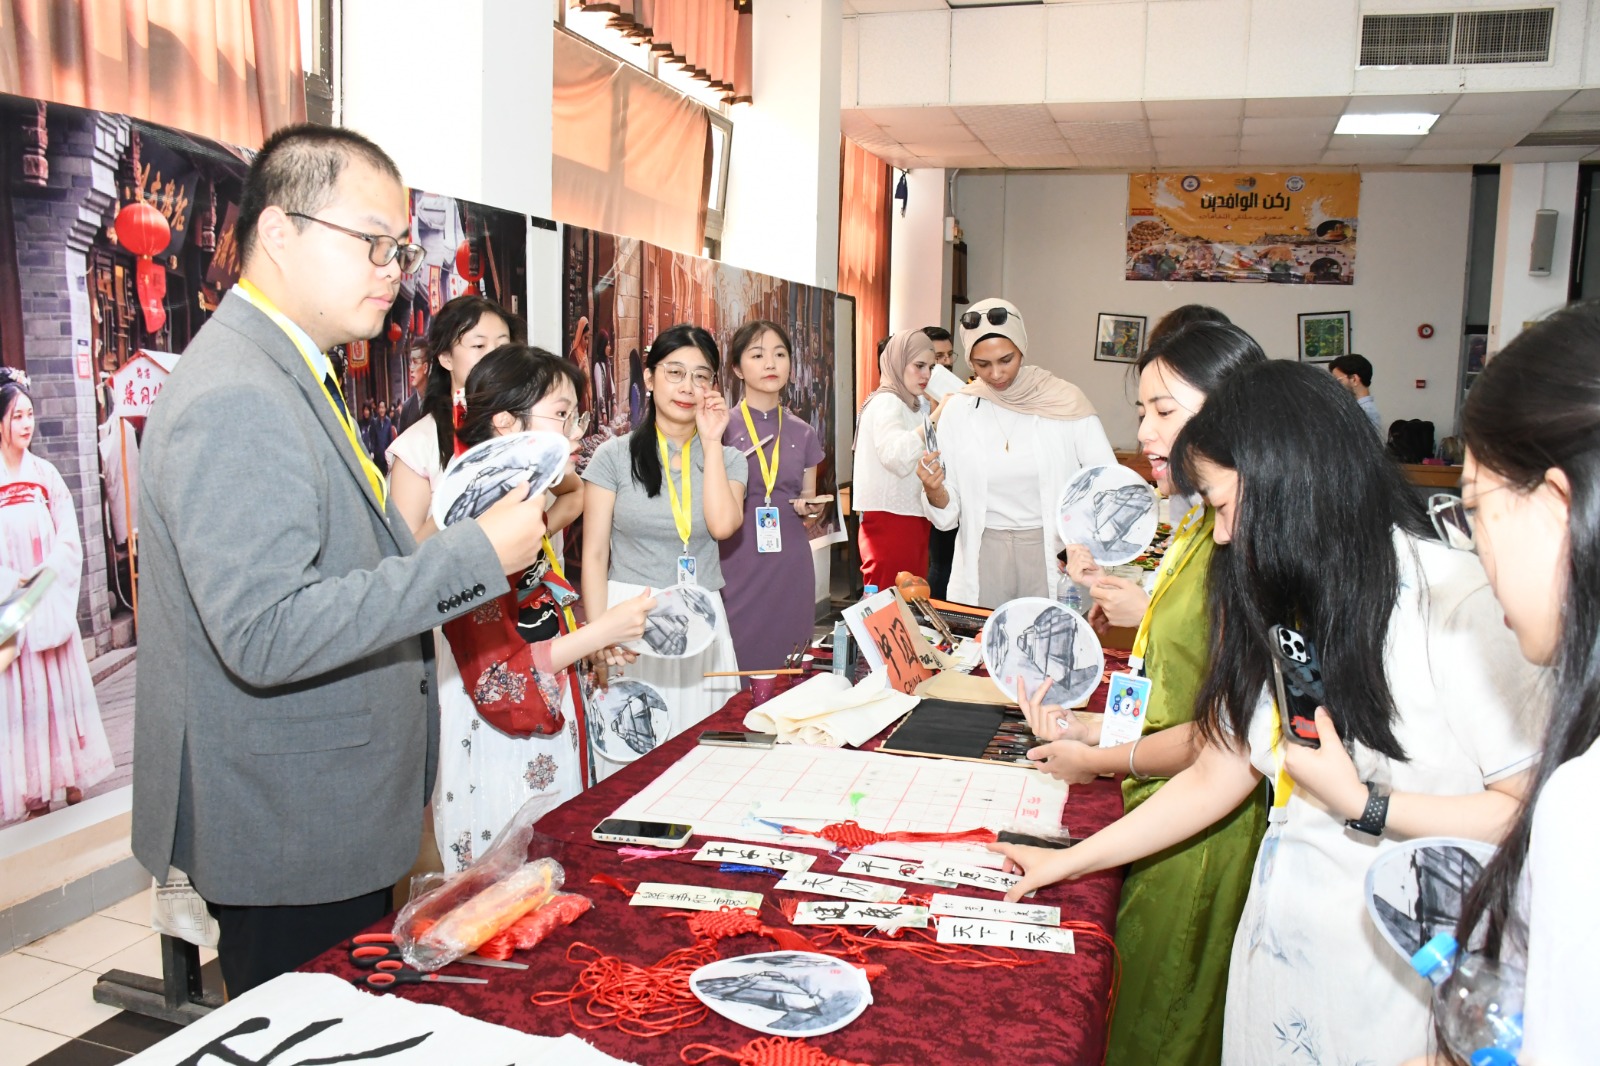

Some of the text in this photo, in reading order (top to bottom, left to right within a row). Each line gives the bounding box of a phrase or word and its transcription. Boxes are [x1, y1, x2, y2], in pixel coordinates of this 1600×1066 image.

[1200, 192, 1291, 212] ركن الوافدين
[953, 924, 1052, 944] 天下一家
